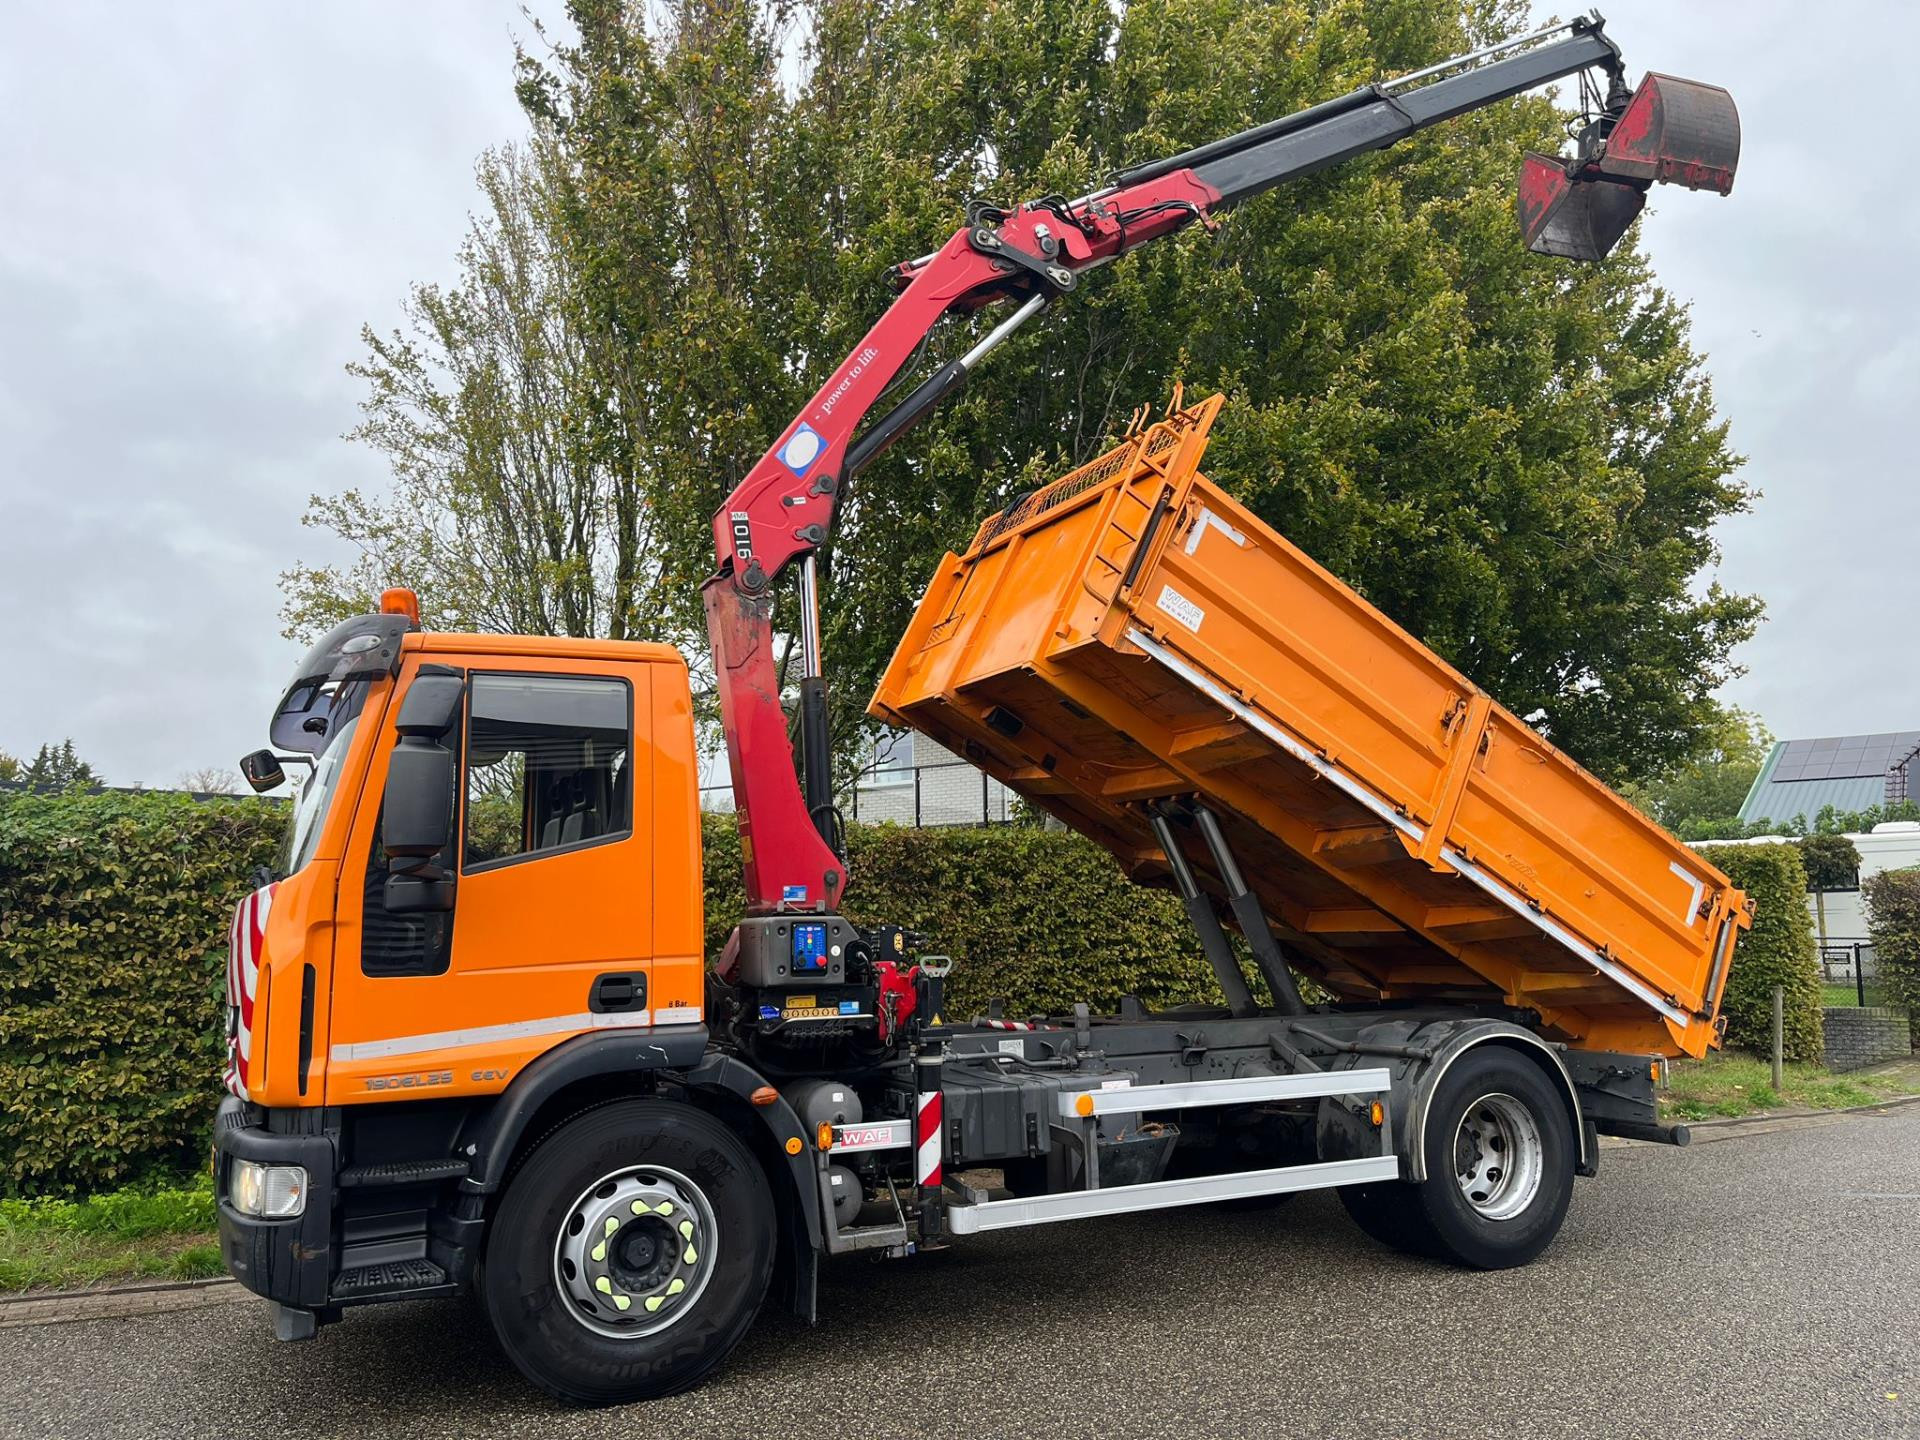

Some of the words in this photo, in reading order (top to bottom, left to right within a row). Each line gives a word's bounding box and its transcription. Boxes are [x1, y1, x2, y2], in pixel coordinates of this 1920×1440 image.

[821, 377, 852, 415] power
[849, 365, 862, 379] to
[857, 347, 879, 367] lift.
[734, 525, 752, 560] 910
[1165, 588, 1202, 618] WAF
[675, 1000, 688, 1008] Bar
[365, 1071, 453, 1091] 190EL25
[471, 1069, 509, 1082] EEV
[843, 1130, 889, 1144] WAF
